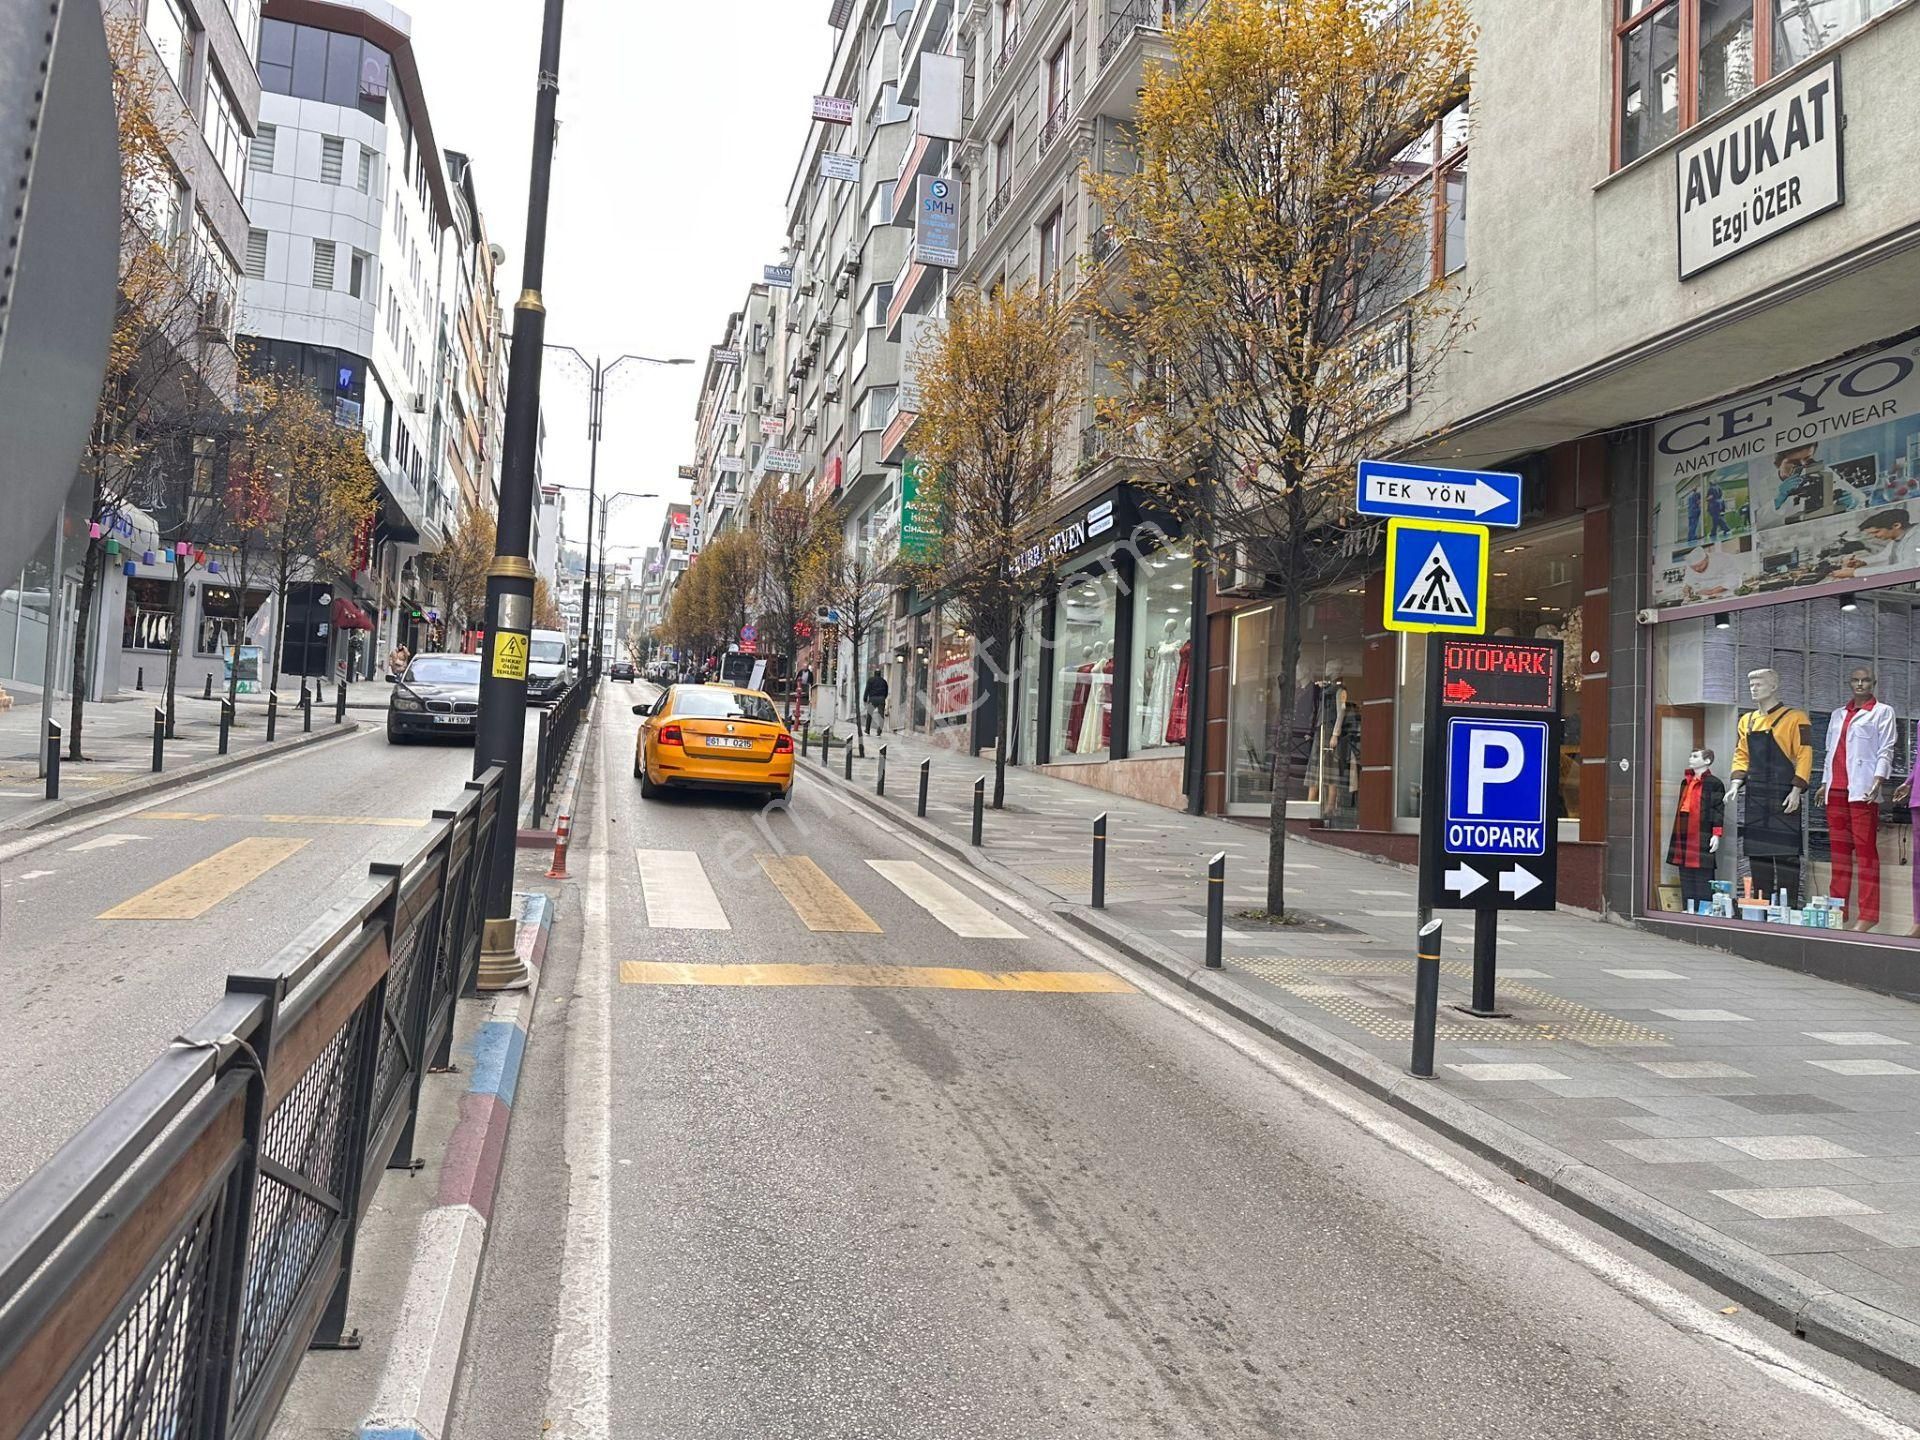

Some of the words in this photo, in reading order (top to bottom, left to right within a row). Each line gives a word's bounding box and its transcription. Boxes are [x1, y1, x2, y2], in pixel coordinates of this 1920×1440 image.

[1685, 79, 1829, 213] AVUKAT
[924, 199, 954, 215] SMH
[1713, 202, 1747, 247] Ezgi
[1753, 176, 1802, 226] ÖZER
[1658, 357, 1914, 455] CEYO
[1674, 438, 1766, 476] ANATOMIC
[1775, 399, 1897, 447] FOOTWEAR
[1376, 481, 1411, 498] TEK
[1427, 485, 1466, 504] YÖN
[1049, 519, 1085, 556] SEVEN
[1447, 647, 1547, 675] OTOPARK
[733, 740, 751, 748] 0215
[1467, 729, 1526, 815] P
[1449, 824, 1540, 849] OTOPARK
